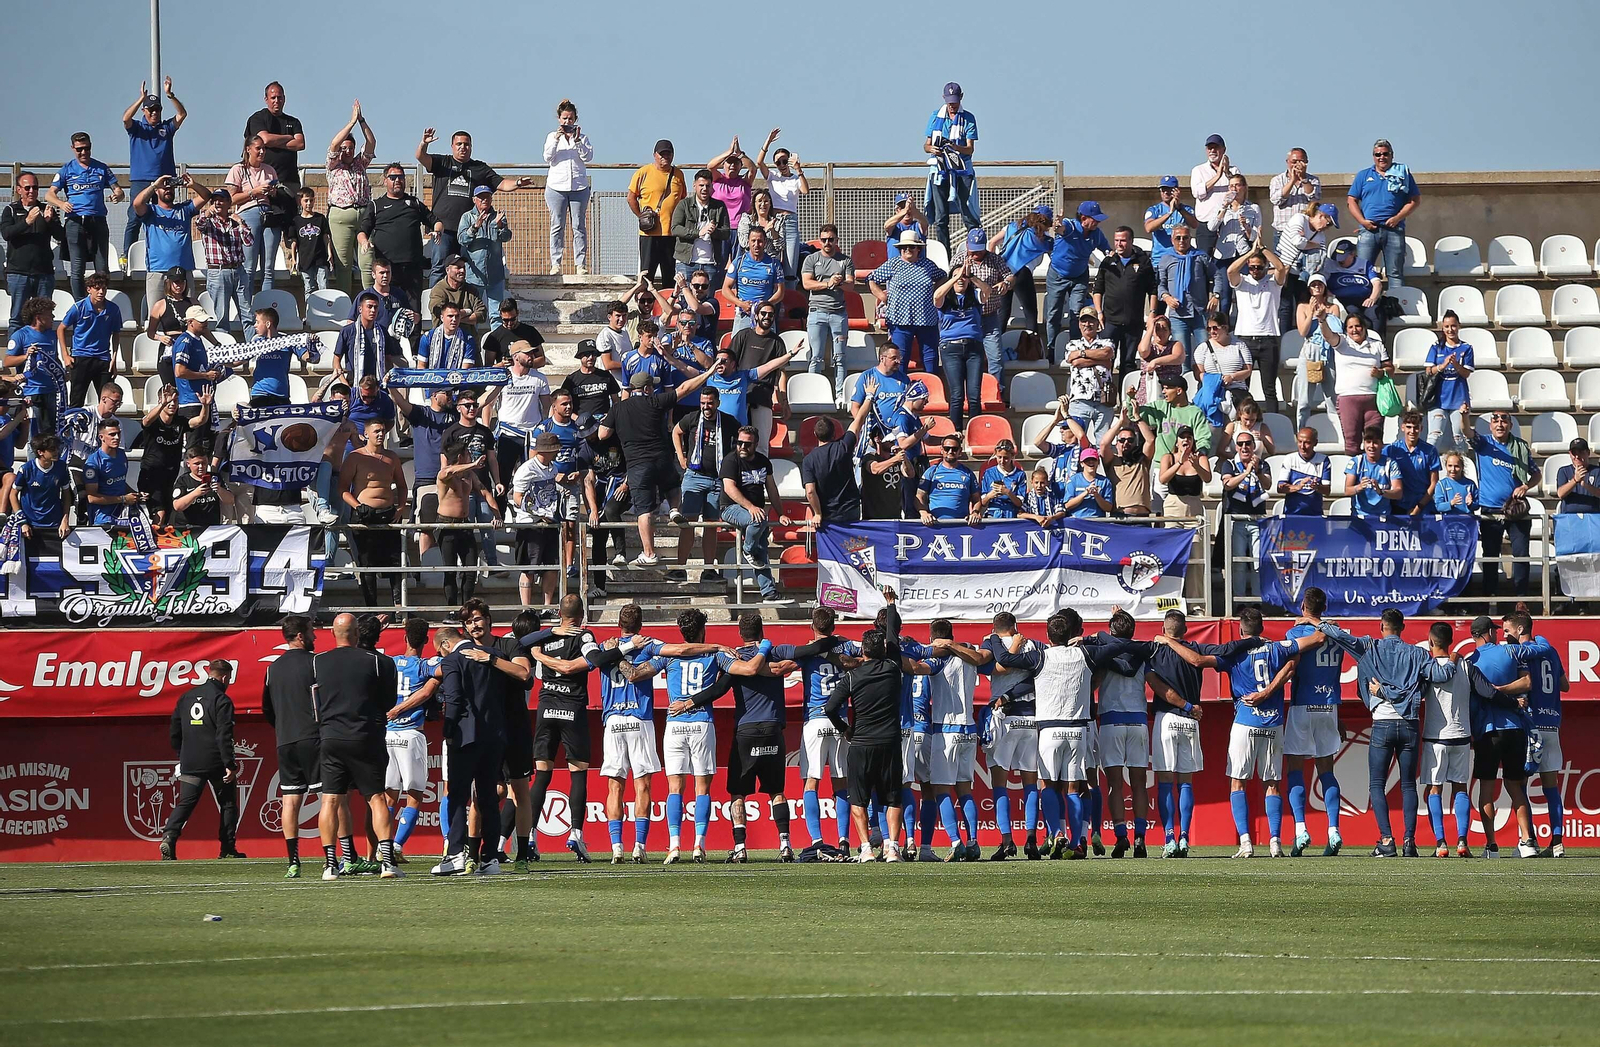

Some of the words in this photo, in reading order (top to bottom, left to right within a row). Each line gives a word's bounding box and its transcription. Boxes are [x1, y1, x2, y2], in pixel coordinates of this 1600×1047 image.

[894, 527, 1111, 562] PALANTE
[1375, 526, 1422, 552] PEÑA
[1325, 557, 1395, 578] TEMPLO
[902, 587, 949, 600] FIELES
[953, 586, 970, 599] AL
[974, 586, 1004, 599] SAN
[1008, 584, 1078, 599] FERNANDO
[1082, 586, 1100, 599] CD
[1344, 590, 1366, 604] Un
[1316, 640, 1341, 667] 22
[680, 661, 704, 696] 19
[1254, 658, 1271, 693] 9
[1541, 661, 1554, 694] 6
[20, 762, 70, 781] MISMA
